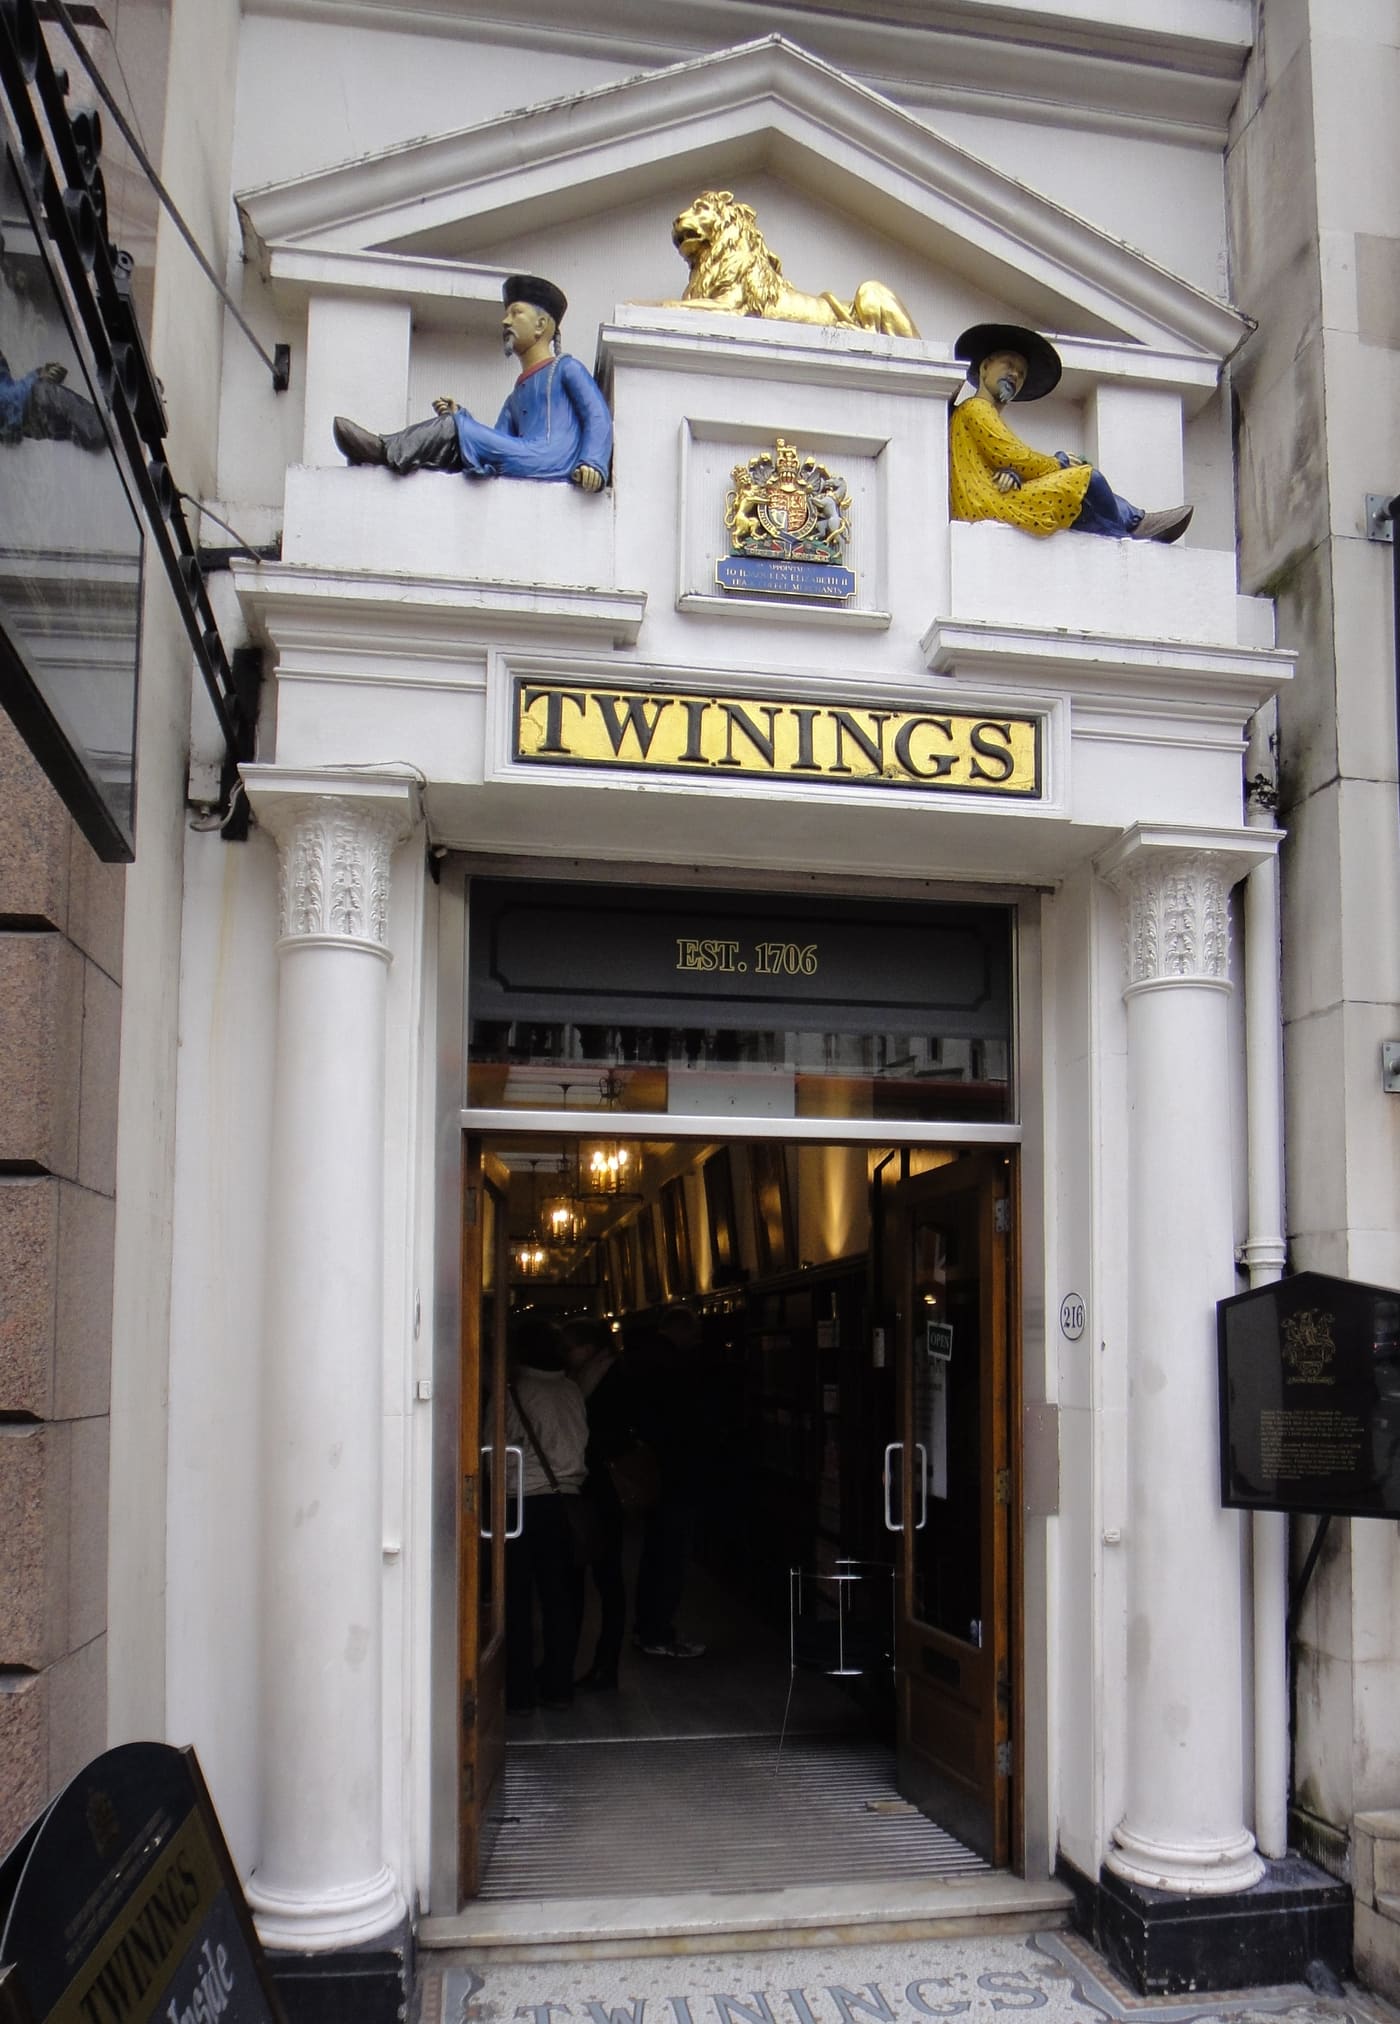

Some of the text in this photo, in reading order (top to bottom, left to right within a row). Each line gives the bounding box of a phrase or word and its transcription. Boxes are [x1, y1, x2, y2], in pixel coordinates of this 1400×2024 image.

[524, 691, 1014, 782] TWININGS
[676, 939, 817, 975] EST. 1706
[1063, 1305, 1083, 1329] 216
[929, 1330, 950, 1348] OPEN
